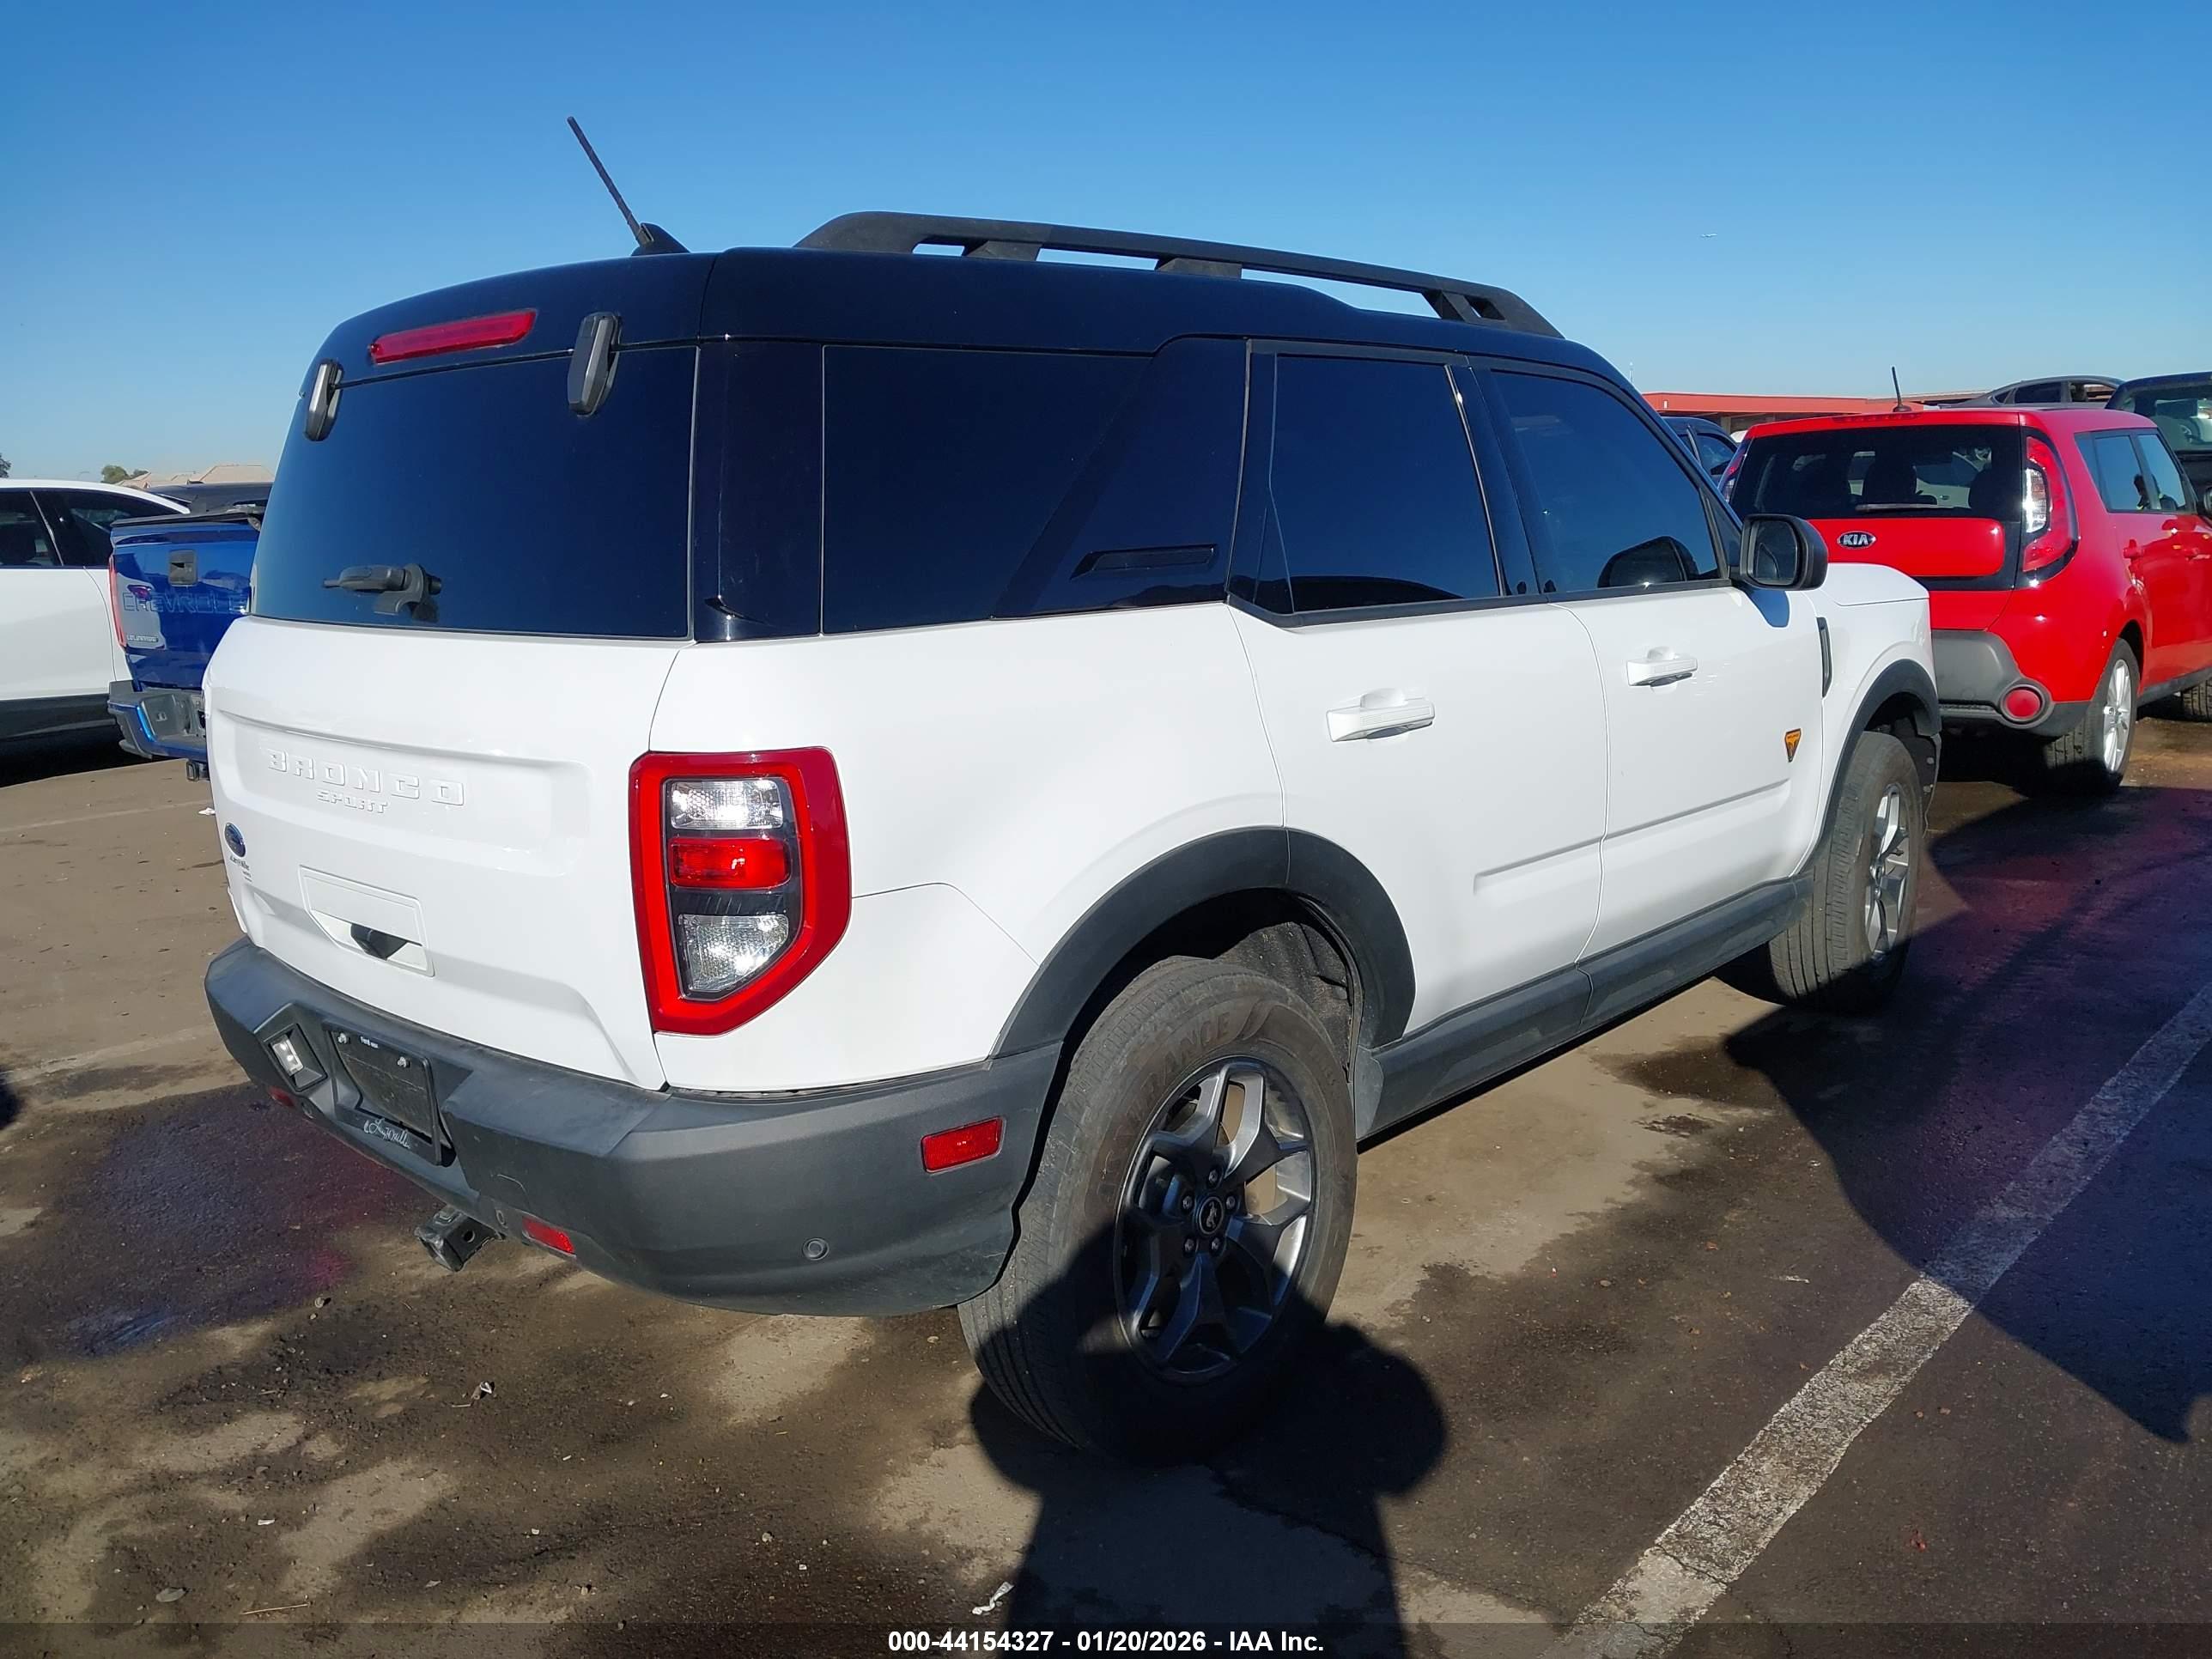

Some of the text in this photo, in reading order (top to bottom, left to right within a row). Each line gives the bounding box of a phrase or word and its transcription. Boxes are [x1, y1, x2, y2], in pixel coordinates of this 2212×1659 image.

[1843, 534, 1869, 545] KIA
[123, 592, 248, 614] CHEVROLE
[265, 748, 465, 806] BRONCO
[318, 789, 390, 814] SPORT
